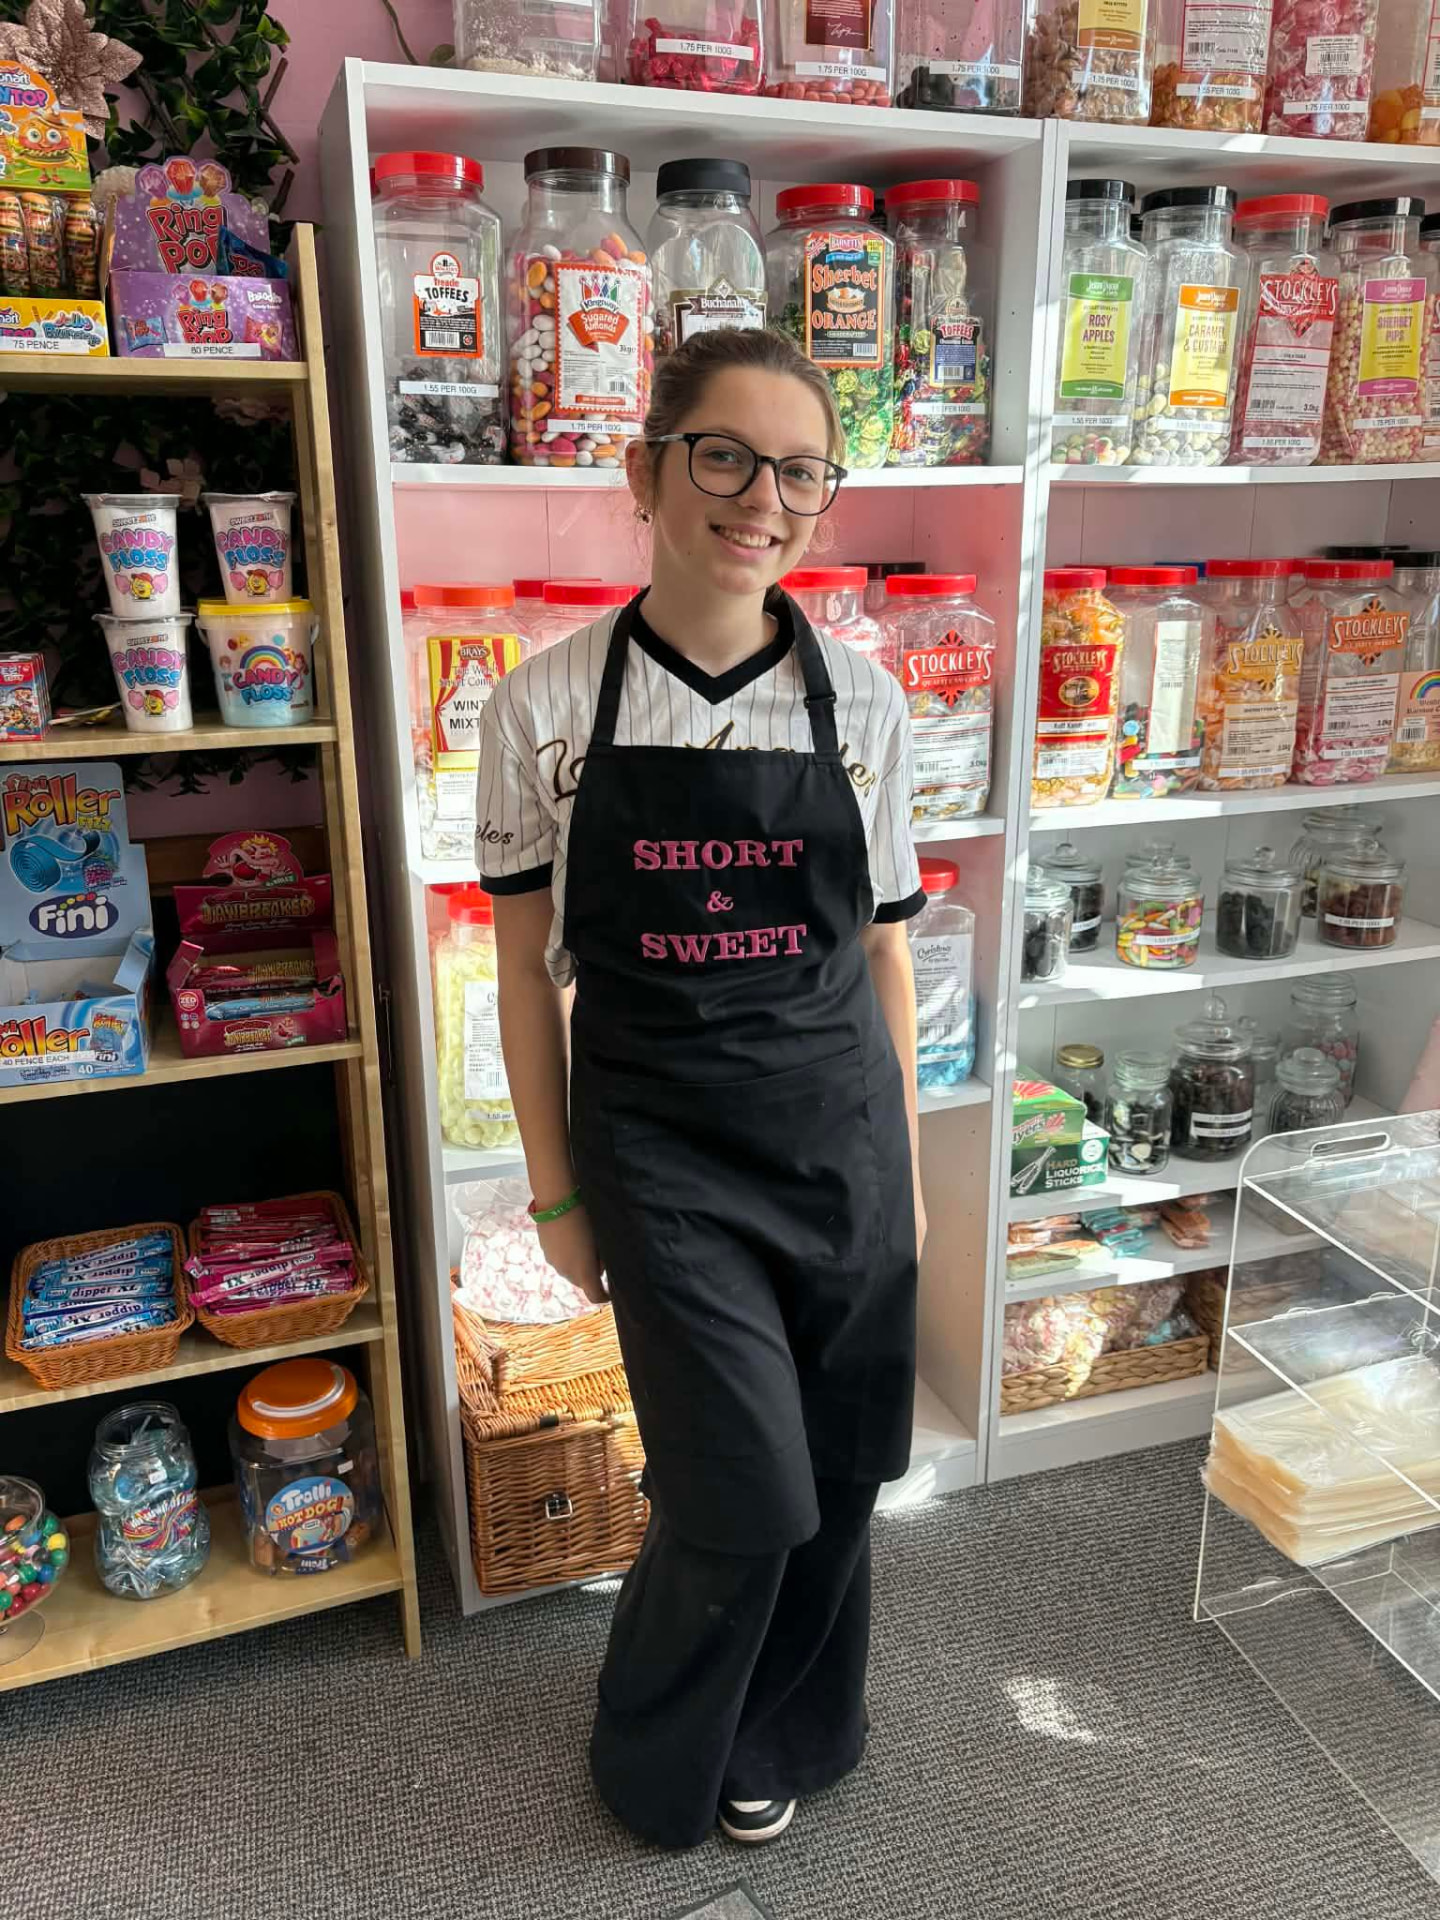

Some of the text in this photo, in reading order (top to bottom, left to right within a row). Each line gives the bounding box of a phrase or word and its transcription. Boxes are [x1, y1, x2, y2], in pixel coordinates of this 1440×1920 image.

[697, 44, 713, 52] PER
[834, 65, 849, 74] PER
[1106, 76, 1120, 85] PER
[1212, 86, 1225, 95] PER
[147, 203, 227, 241] Ring
[812, 263, 877, 293] Sherbet
[425, 286, 470, 303] TOFFEES
[176, 309, 228, 332] Ring
[581, 313, 619, 325] Sugared
[811, 309, 877, 330] ORANGE
[1088, 314, 1113, 328] ROSY
[940, 323, 975, 339] TOFFEES
[1082, 329, 1116, 344] APPLES
[1385, 329, 1406, 343] PIPS
[14, 339, 60, 350] 75 PENCE
[202, 346, 234, 355] PENCE
[440, 385, 456, 393] PER
[458, 386, 477, 395] 100G
[587, 423, 603, 432] PER
[101, 527, 175, 553] CANDY
[215, 526, 288, 553] CANDY
[108, 546, 168, 571] FLOSS
[224, 544, 286, 570] FLOSS
[1332, 615, 1408, 649] STOCKLEYS
[112, 648, 185, 672] CANDY
[461, 646, 488, 658] BRAYS
[1052, 650, 1108, 674] STOCKLEYS
[1228, 642, 1304, 675] STOCKLEYS
[121, 667, 181, 690] FLOSS
[232, 668, 300, 690] CANDY
[908, 650, 993, 687] STOCKLEYS
[240, 685, 294, 706] FLOSS
[453, 700, 486, 712] WINT
[449, 718, 481, 730] MIXT
[2, 772, 122, 836] Roller
[632, 838, 804, 872] SHORT
[705, 890, 735, 914] &
[640, 923, 808, 964] SWEET
[0, 1015, 91, 1058] oller
[45, 1055, 70, 1064] EACH
[78, 1063, 94, 1075] 40
[1046, 1159, 1078, 1169] HARD
[1045, 1176, 1084, 1189] STICKS
[72, 1284, 139, 1299] dipper XL
[281, 1483, 332, 1511] Trolli
[278, 1499, 338, 1531] HOT DOG
